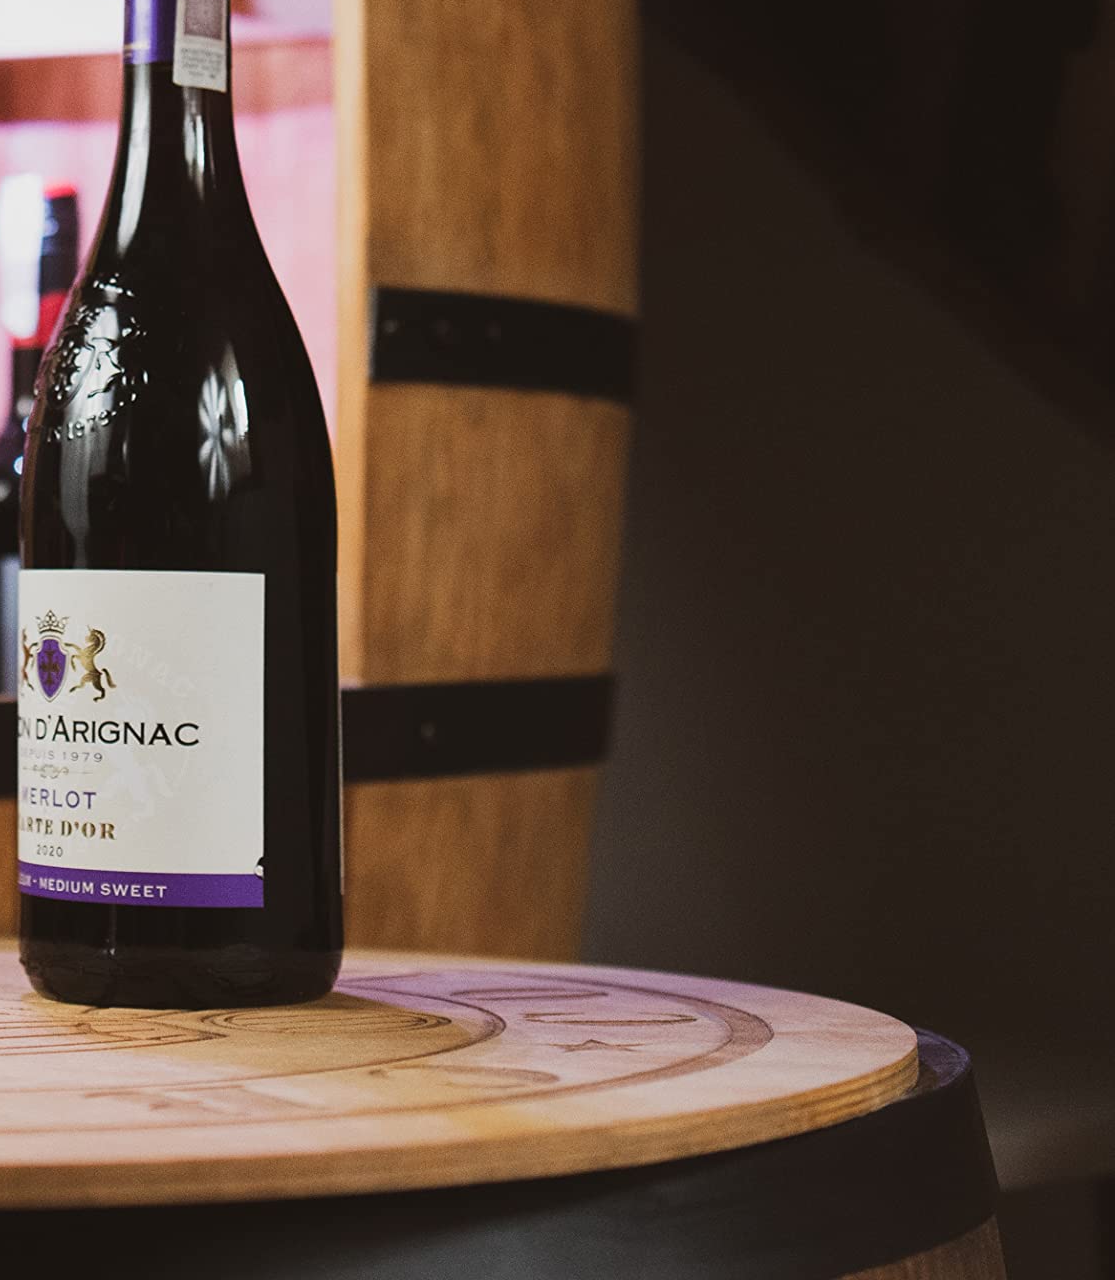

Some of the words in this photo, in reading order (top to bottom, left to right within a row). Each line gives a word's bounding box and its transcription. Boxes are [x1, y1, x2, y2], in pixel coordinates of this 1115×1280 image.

[36, 714, 200, 747] D'ARIGNAC
[62, 751, 104, 763] 1979
[18, 815, 53, 836] ARTE
[61, 820, 117, 841] D'OR
[36, 844, 64, 858] 2020
[39, 877, 95, 895] MEDIUM
[100, 883, 168, 899] SWEET
